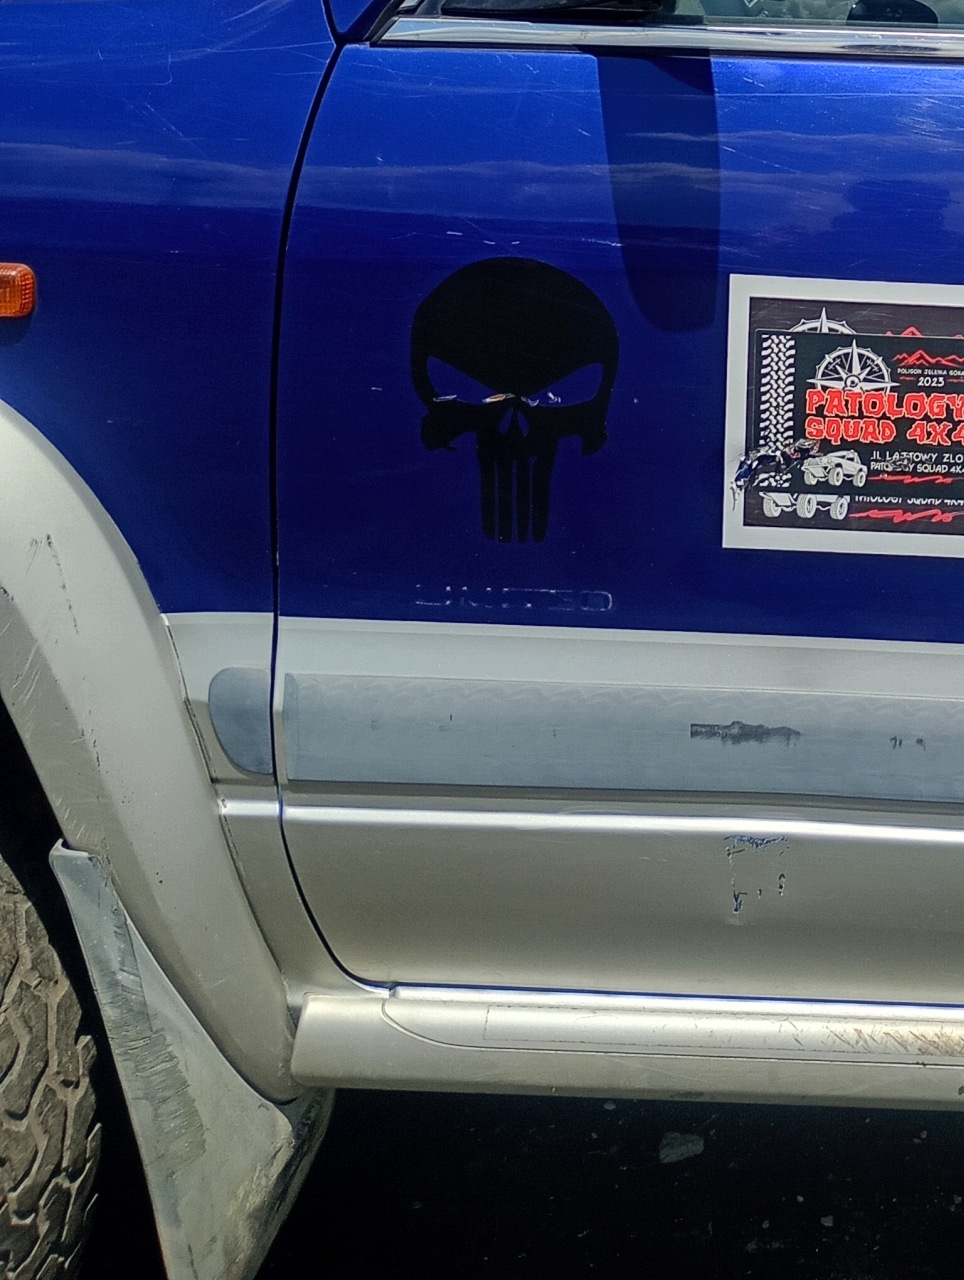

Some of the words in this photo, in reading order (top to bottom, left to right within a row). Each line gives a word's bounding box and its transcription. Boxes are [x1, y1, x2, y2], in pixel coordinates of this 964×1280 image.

[917, 377, 945, 387] 2023
[805, 416, 896, 445] SQUAD
[870, 462, 915, 472] PATOGY
[917, 464, 948, 473] SQUAD
